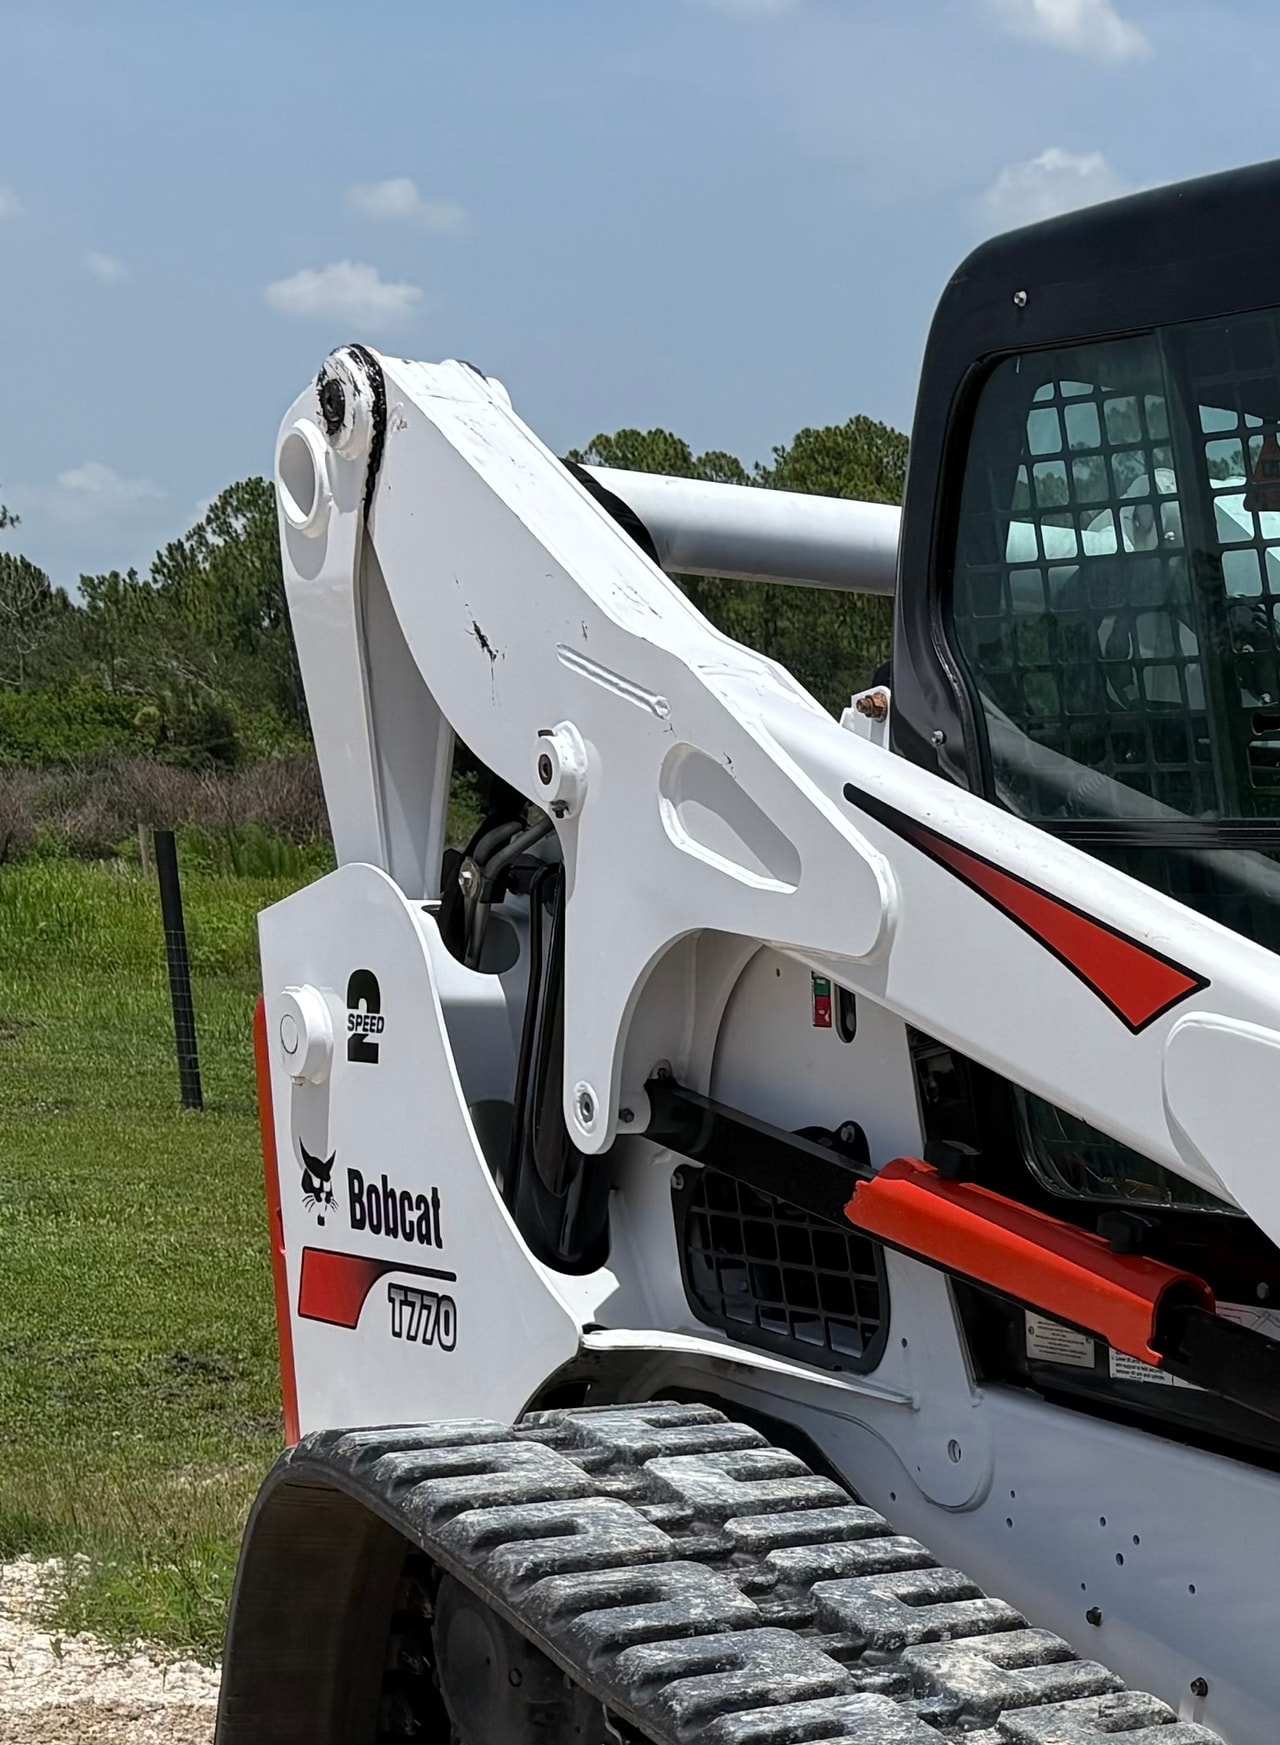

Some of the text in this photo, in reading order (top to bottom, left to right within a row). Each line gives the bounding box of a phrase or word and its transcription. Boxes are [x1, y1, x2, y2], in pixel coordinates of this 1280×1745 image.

[347, 1013, 385, 1034] SPEED
[347, 1167, 443, 1249] Bobcat
[388, 1282, 457, 1352] T770
